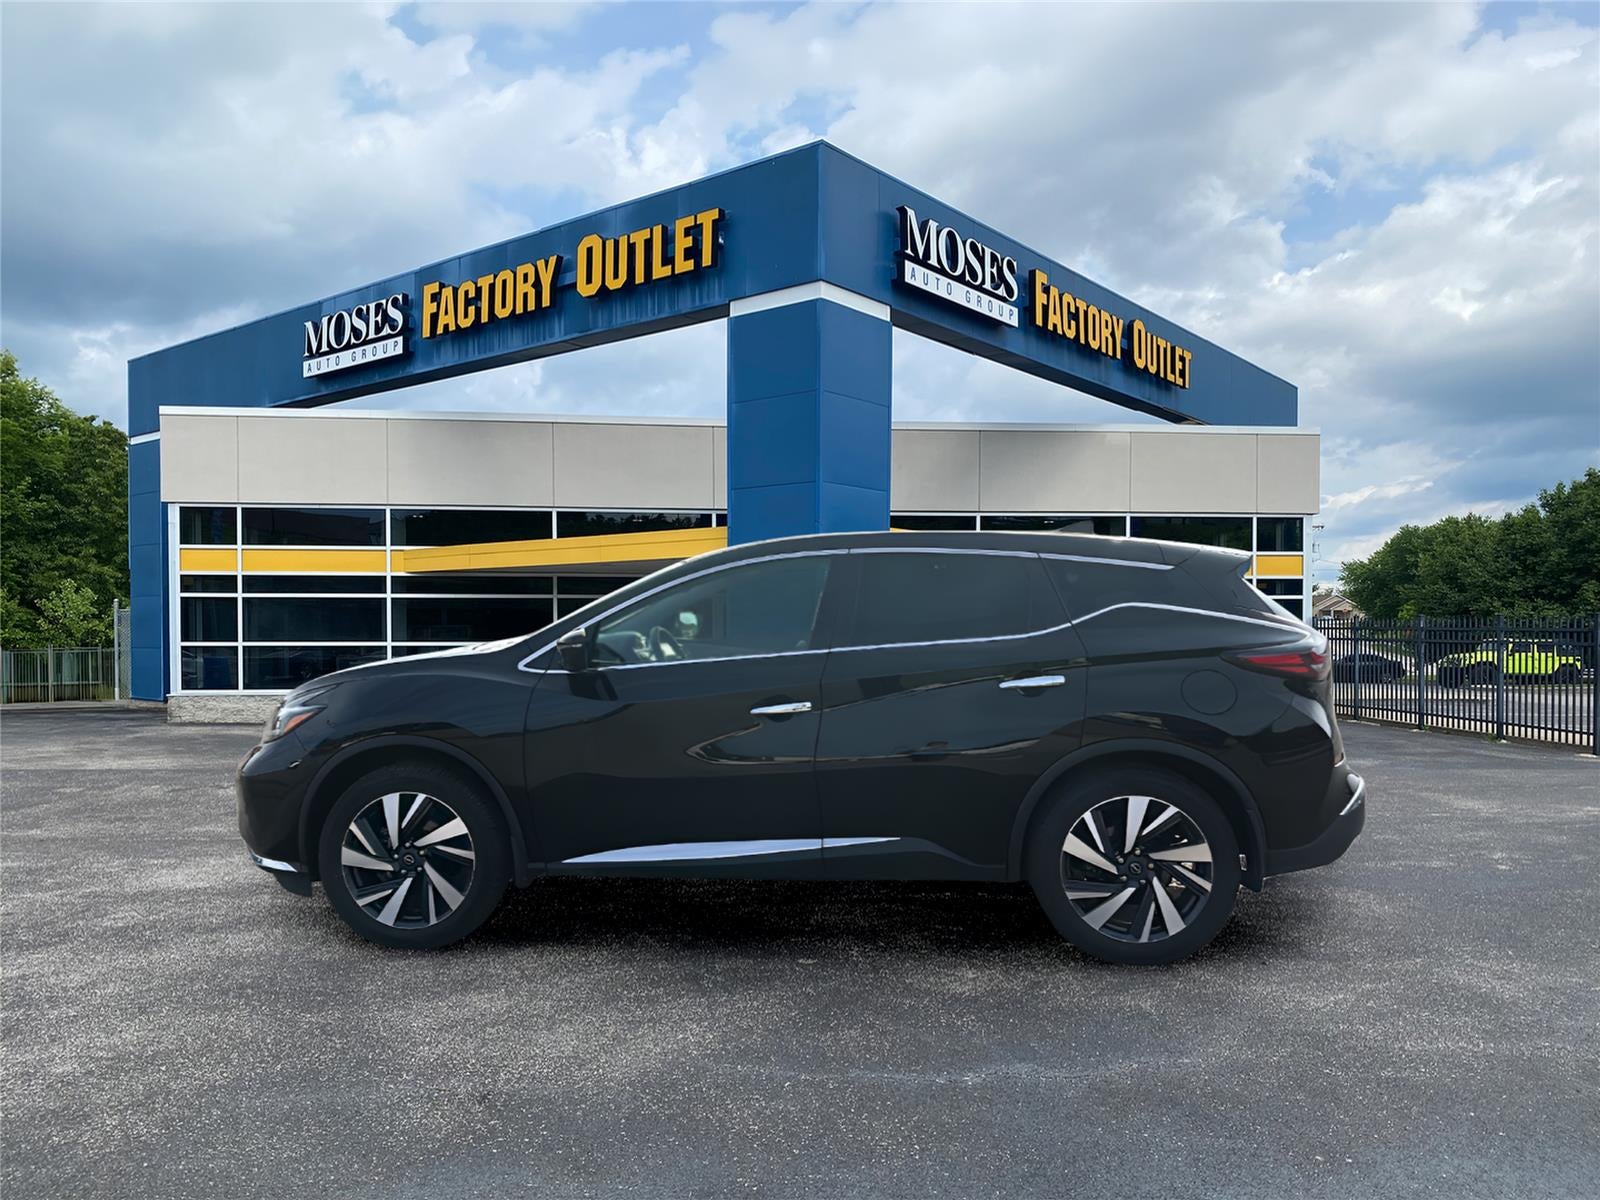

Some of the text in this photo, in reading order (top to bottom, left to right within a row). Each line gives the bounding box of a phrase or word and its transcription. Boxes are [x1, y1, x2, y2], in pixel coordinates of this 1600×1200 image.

[422, 207, 720, 338] FACTORY OUTLET
[904, 205, 1019, 301] MOSES
[303, 294, 404, 357] MOSES
[910, 266, 1016, 321] AUTO GROUP
[1034, 268, 1192, 389] FACTORY OUTLET
[306, 339, 400, 375] AUTO GROUP
